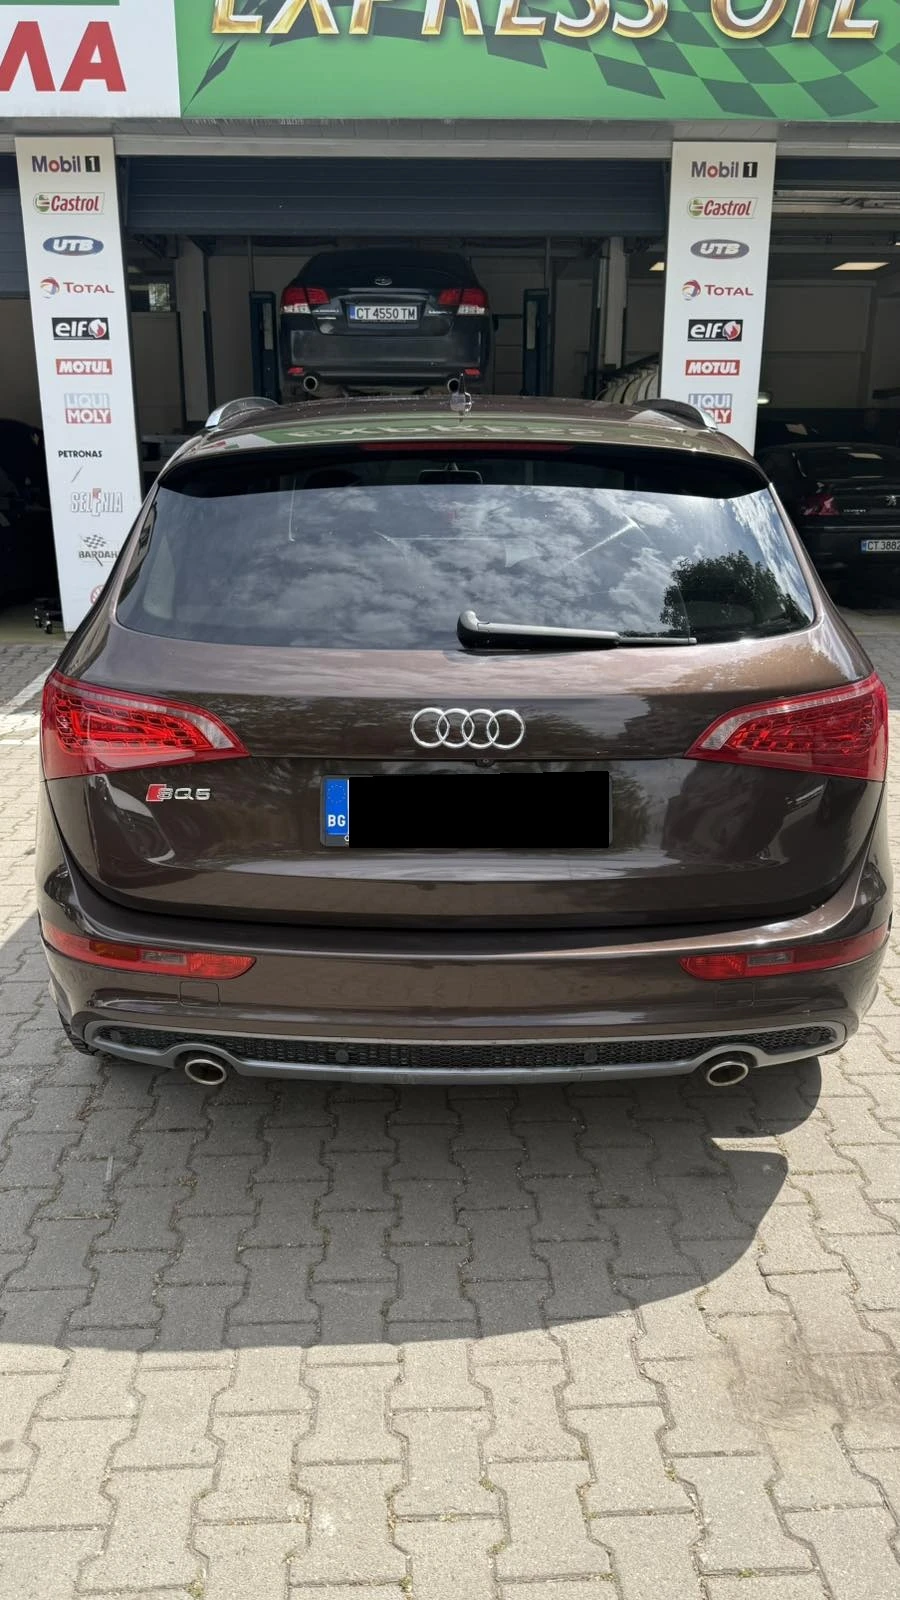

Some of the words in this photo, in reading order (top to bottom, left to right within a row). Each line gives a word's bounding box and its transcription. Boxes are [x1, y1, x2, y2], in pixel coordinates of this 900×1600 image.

[32, 155, 81, 173] Mobil
[87, 156, 98, 172] 1
[691, 161, 739, 178] Mobil
[745, 162, 755, 178] 1
[51, 195, 99, 212] Castrol
[704, 200, 751, 216] Castrol
[52, 239, 94, 251] UTB
[700, 243, 741, 255] UTB
[63, 282, 115, 294] TOTAL
[704, 284, 754, 296] TOTAL
[356, 308, 371, 319] CT
[372, 308, 399, 319] 4550
[400, 308, 416, 319] TM
[55, 320, 88, 337] elf
[690, 322, 724, 339] elf
[58, 360, 110, 373] MOTUL
[687, 362, 738, 374] MOTUL
[65, 393, 110, 408] LIQUI
[690, 394, 731, 408] LIQUI
[67, 409, 111, 424] MOLY
[704, 409, 731, 423] LY
[58, 450, 103, 458] PETRONAS
[71, 488, 124, 517] SELENIA
[867, 541, 879, 551] CT
[78, 550, 119, 563] BARDAH
[156, 787, 211, 801] SQ5
[327, 814, 346, 828] BG
